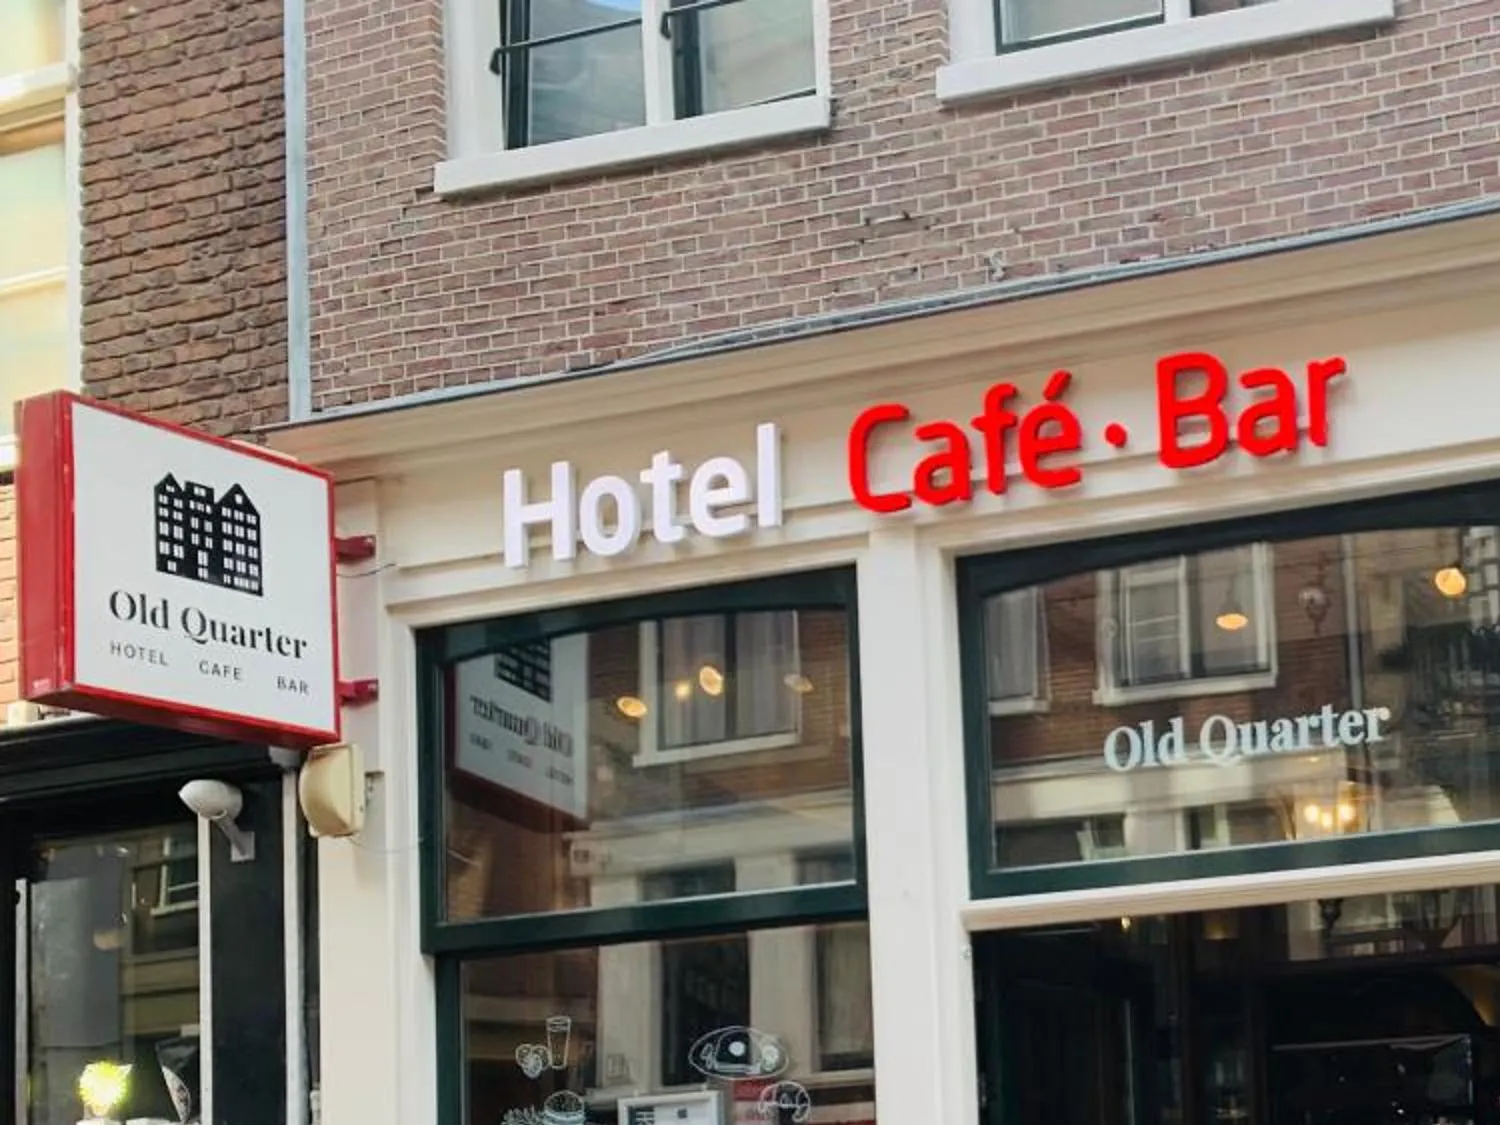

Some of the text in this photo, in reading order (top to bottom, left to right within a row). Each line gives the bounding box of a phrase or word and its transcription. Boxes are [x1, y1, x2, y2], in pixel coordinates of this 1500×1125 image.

[503, 351, 1347, 569] Hotel Café Bar
[109, 591, 307, 659] Old Quarter
[110, 641, 309, 695] HOTEL CAFE BAR
[1104, 704, 1391, 772] Old Quarter
